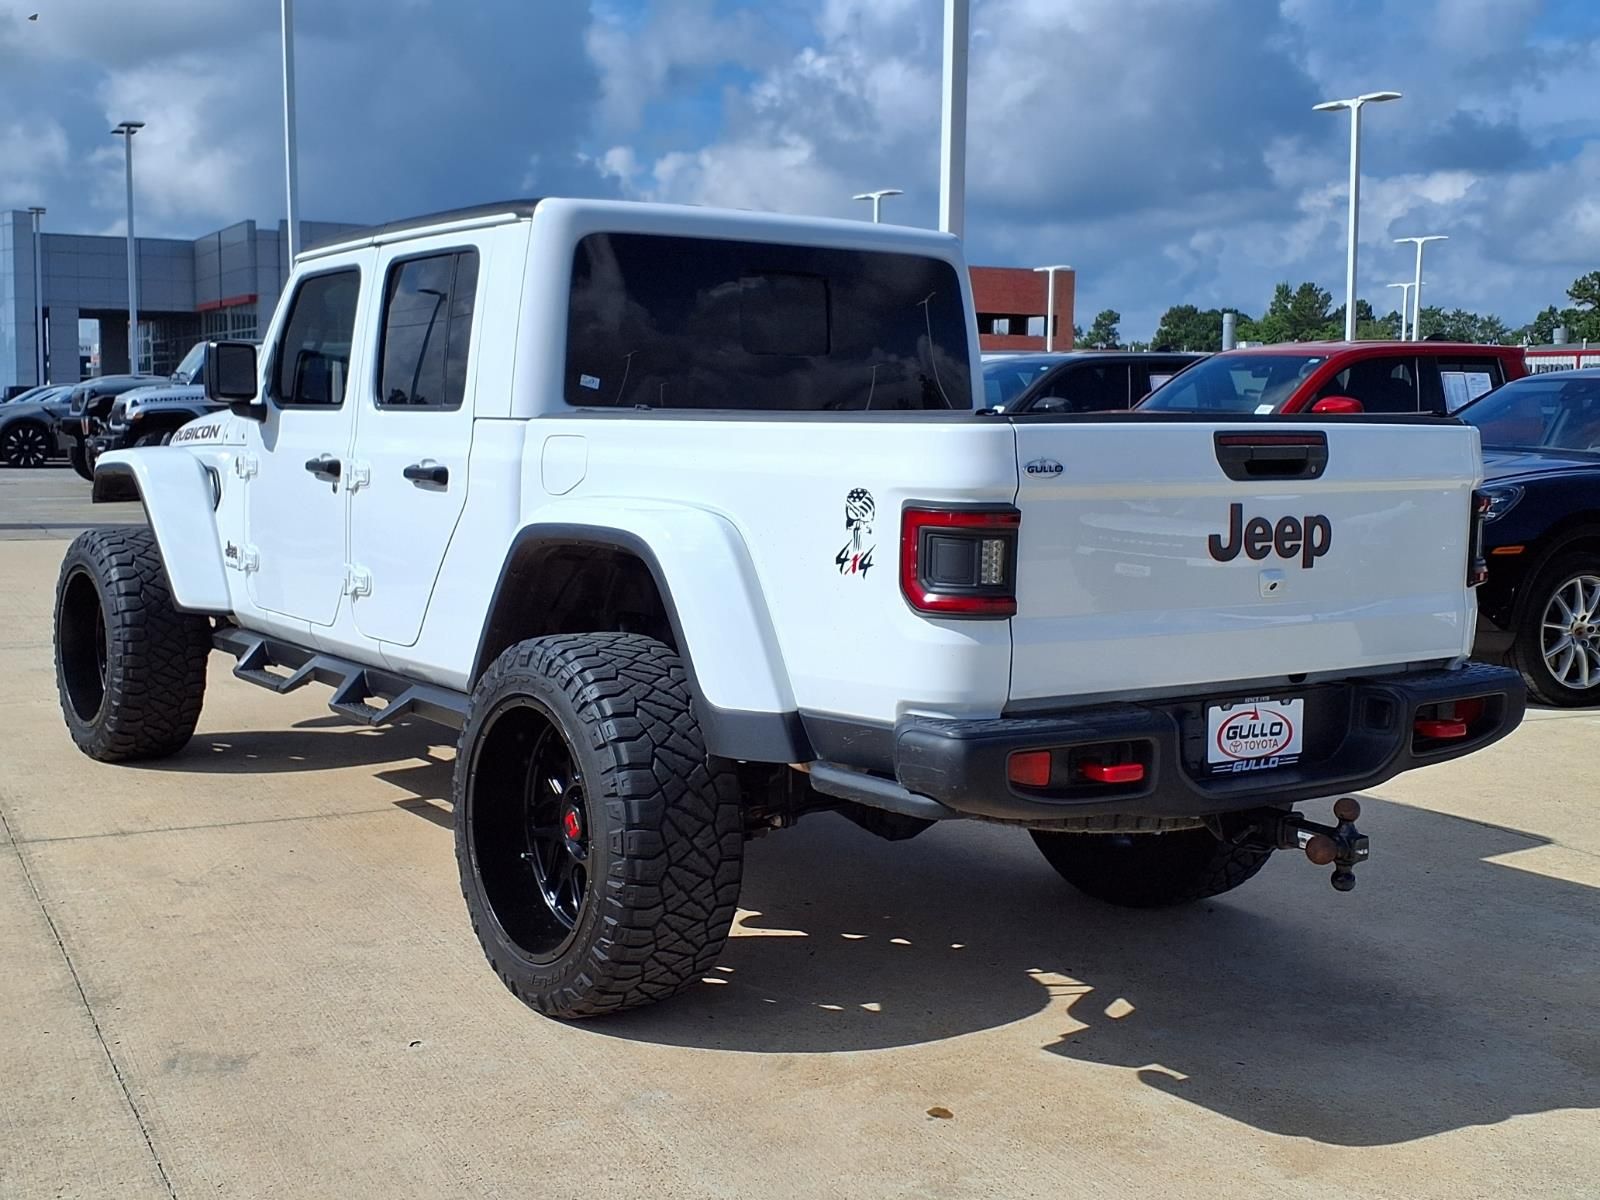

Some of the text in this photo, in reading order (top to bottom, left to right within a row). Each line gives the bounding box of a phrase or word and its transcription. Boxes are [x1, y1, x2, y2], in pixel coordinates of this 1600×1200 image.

[1027, 465, 1064, 473] GULLO
[1208, 502, 1332, 569] Jeep
[1226, 721, 1283, 740] GULLO
[1244, 738, 1279, 751] TOYOTA
[1232, 757, 1280, 773] GULLO
